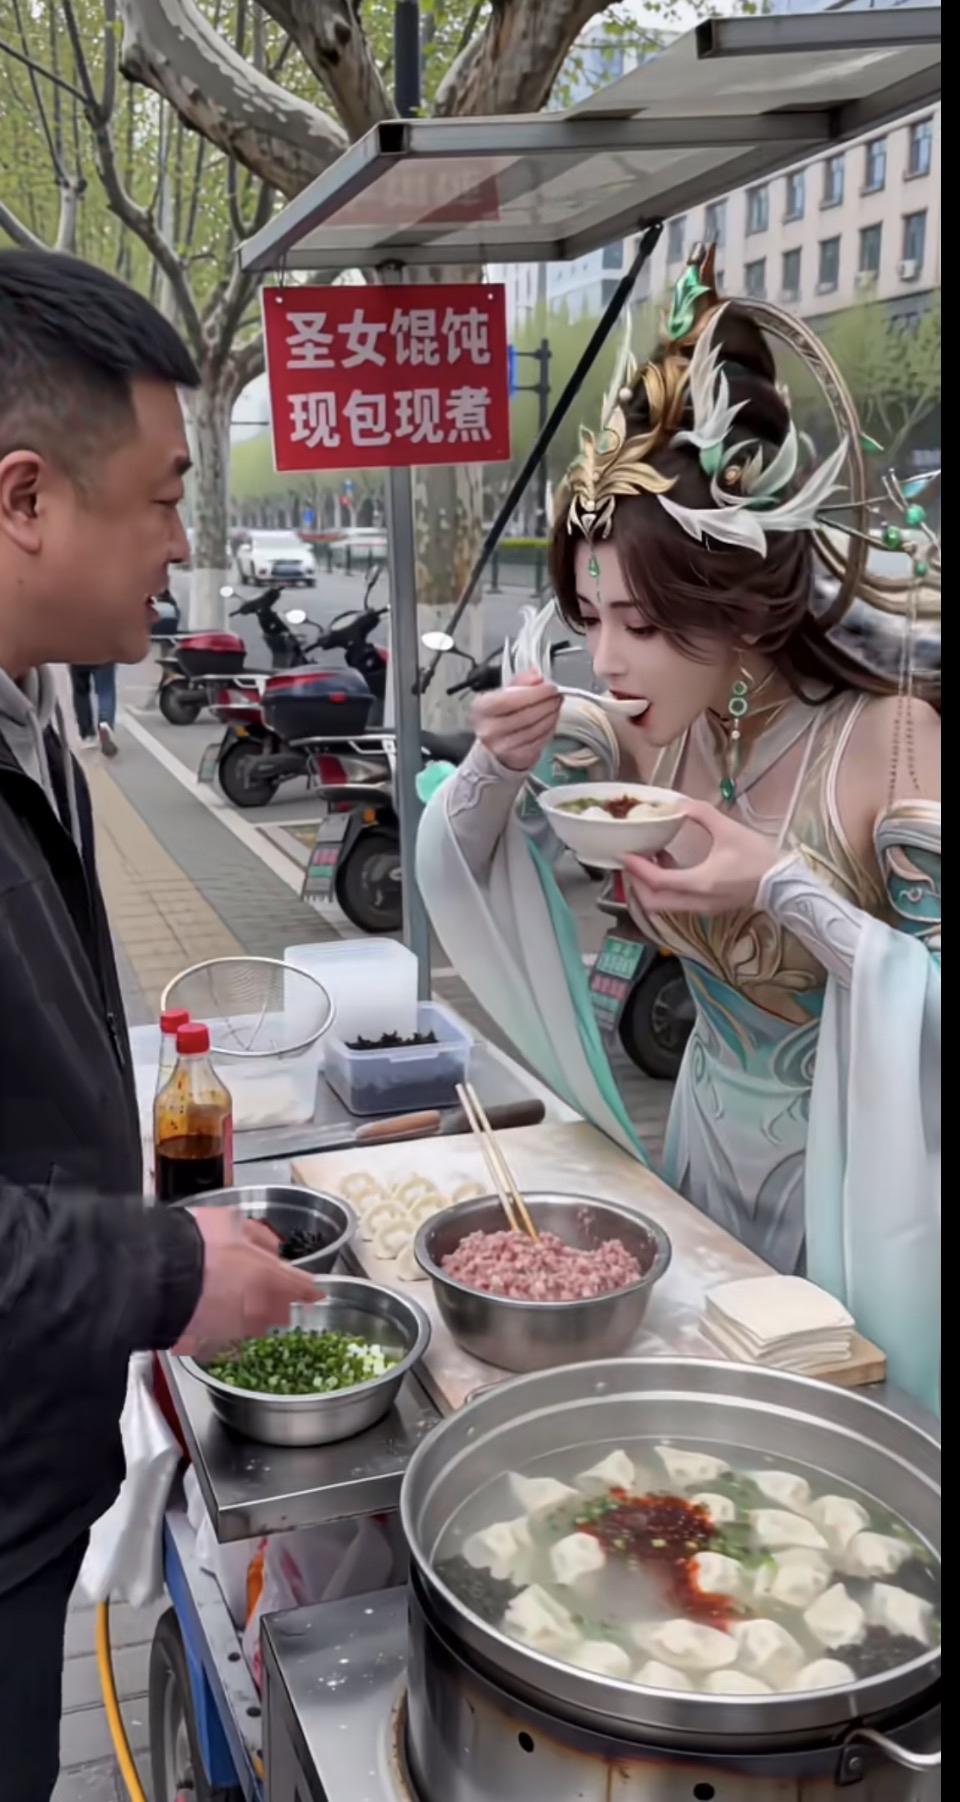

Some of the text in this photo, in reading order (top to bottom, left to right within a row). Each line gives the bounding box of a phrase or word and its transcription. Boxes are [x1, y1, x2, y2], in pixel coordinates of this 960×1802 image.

[286, 307, 491, 369] 圣女馄饨
[287, 386, 492, 448] 现包现煮
